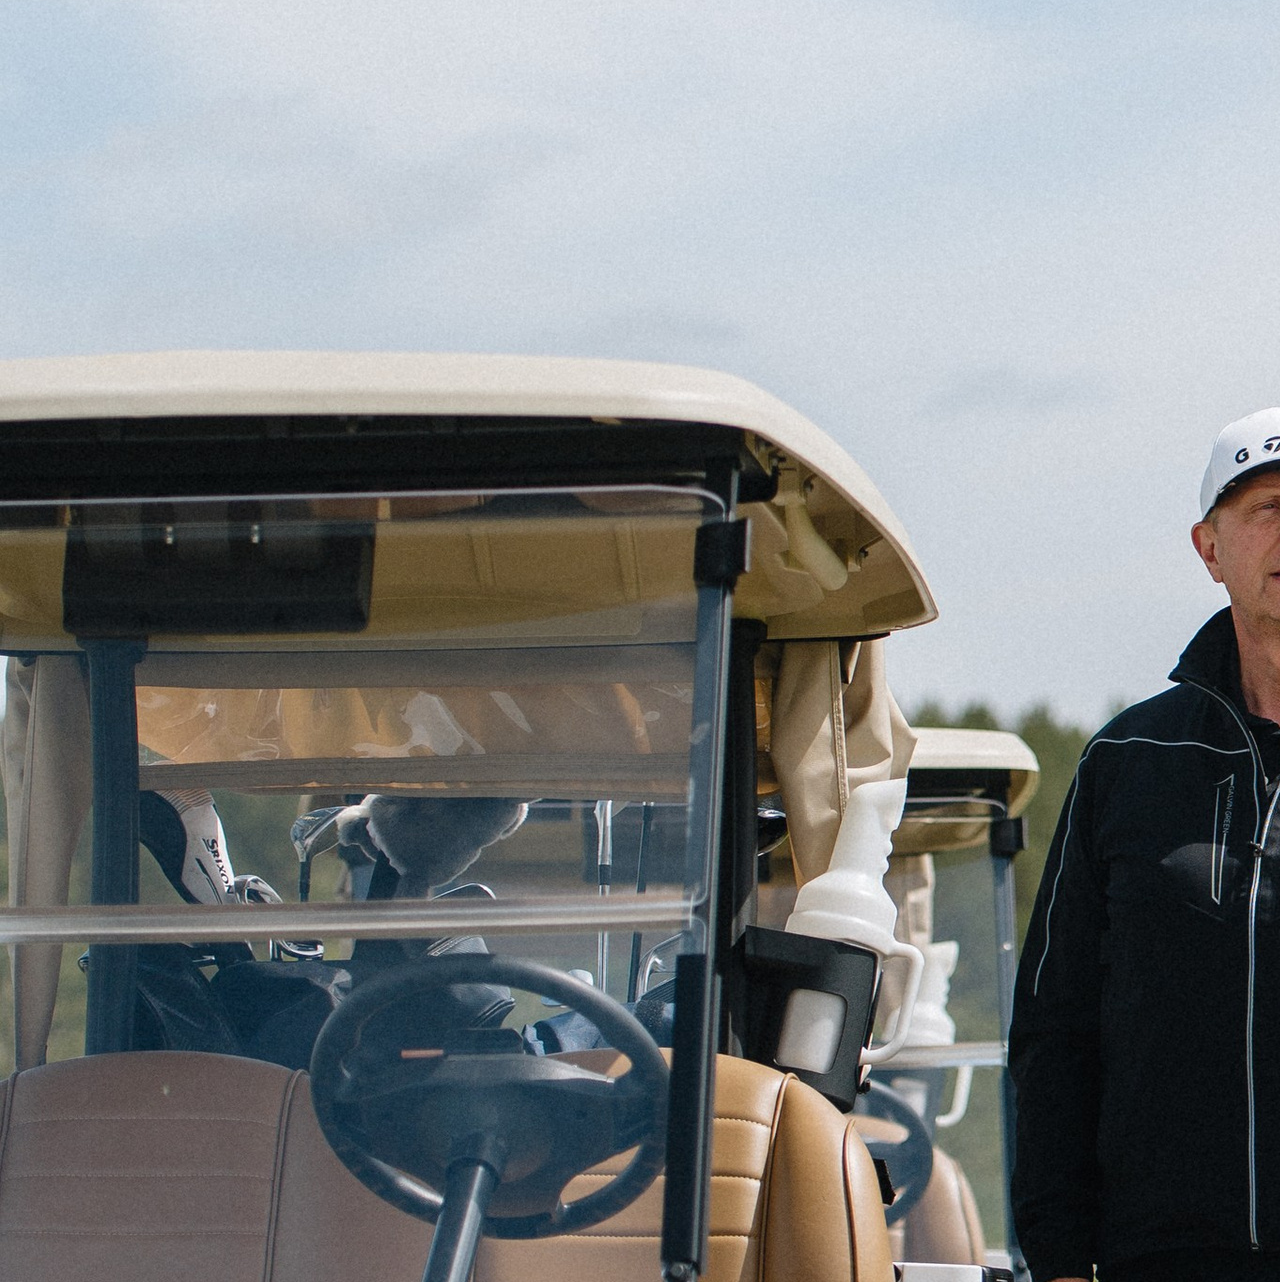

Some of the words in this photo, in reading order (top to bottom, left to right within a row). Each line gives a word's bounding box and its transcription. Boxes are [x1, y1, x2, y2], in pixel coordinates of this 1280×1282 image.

[1226, 786, 1235, 810] GALVIN
[1222, 811, 1232, 834] GREEN
[202, 838, 234, 894] SRIXON
